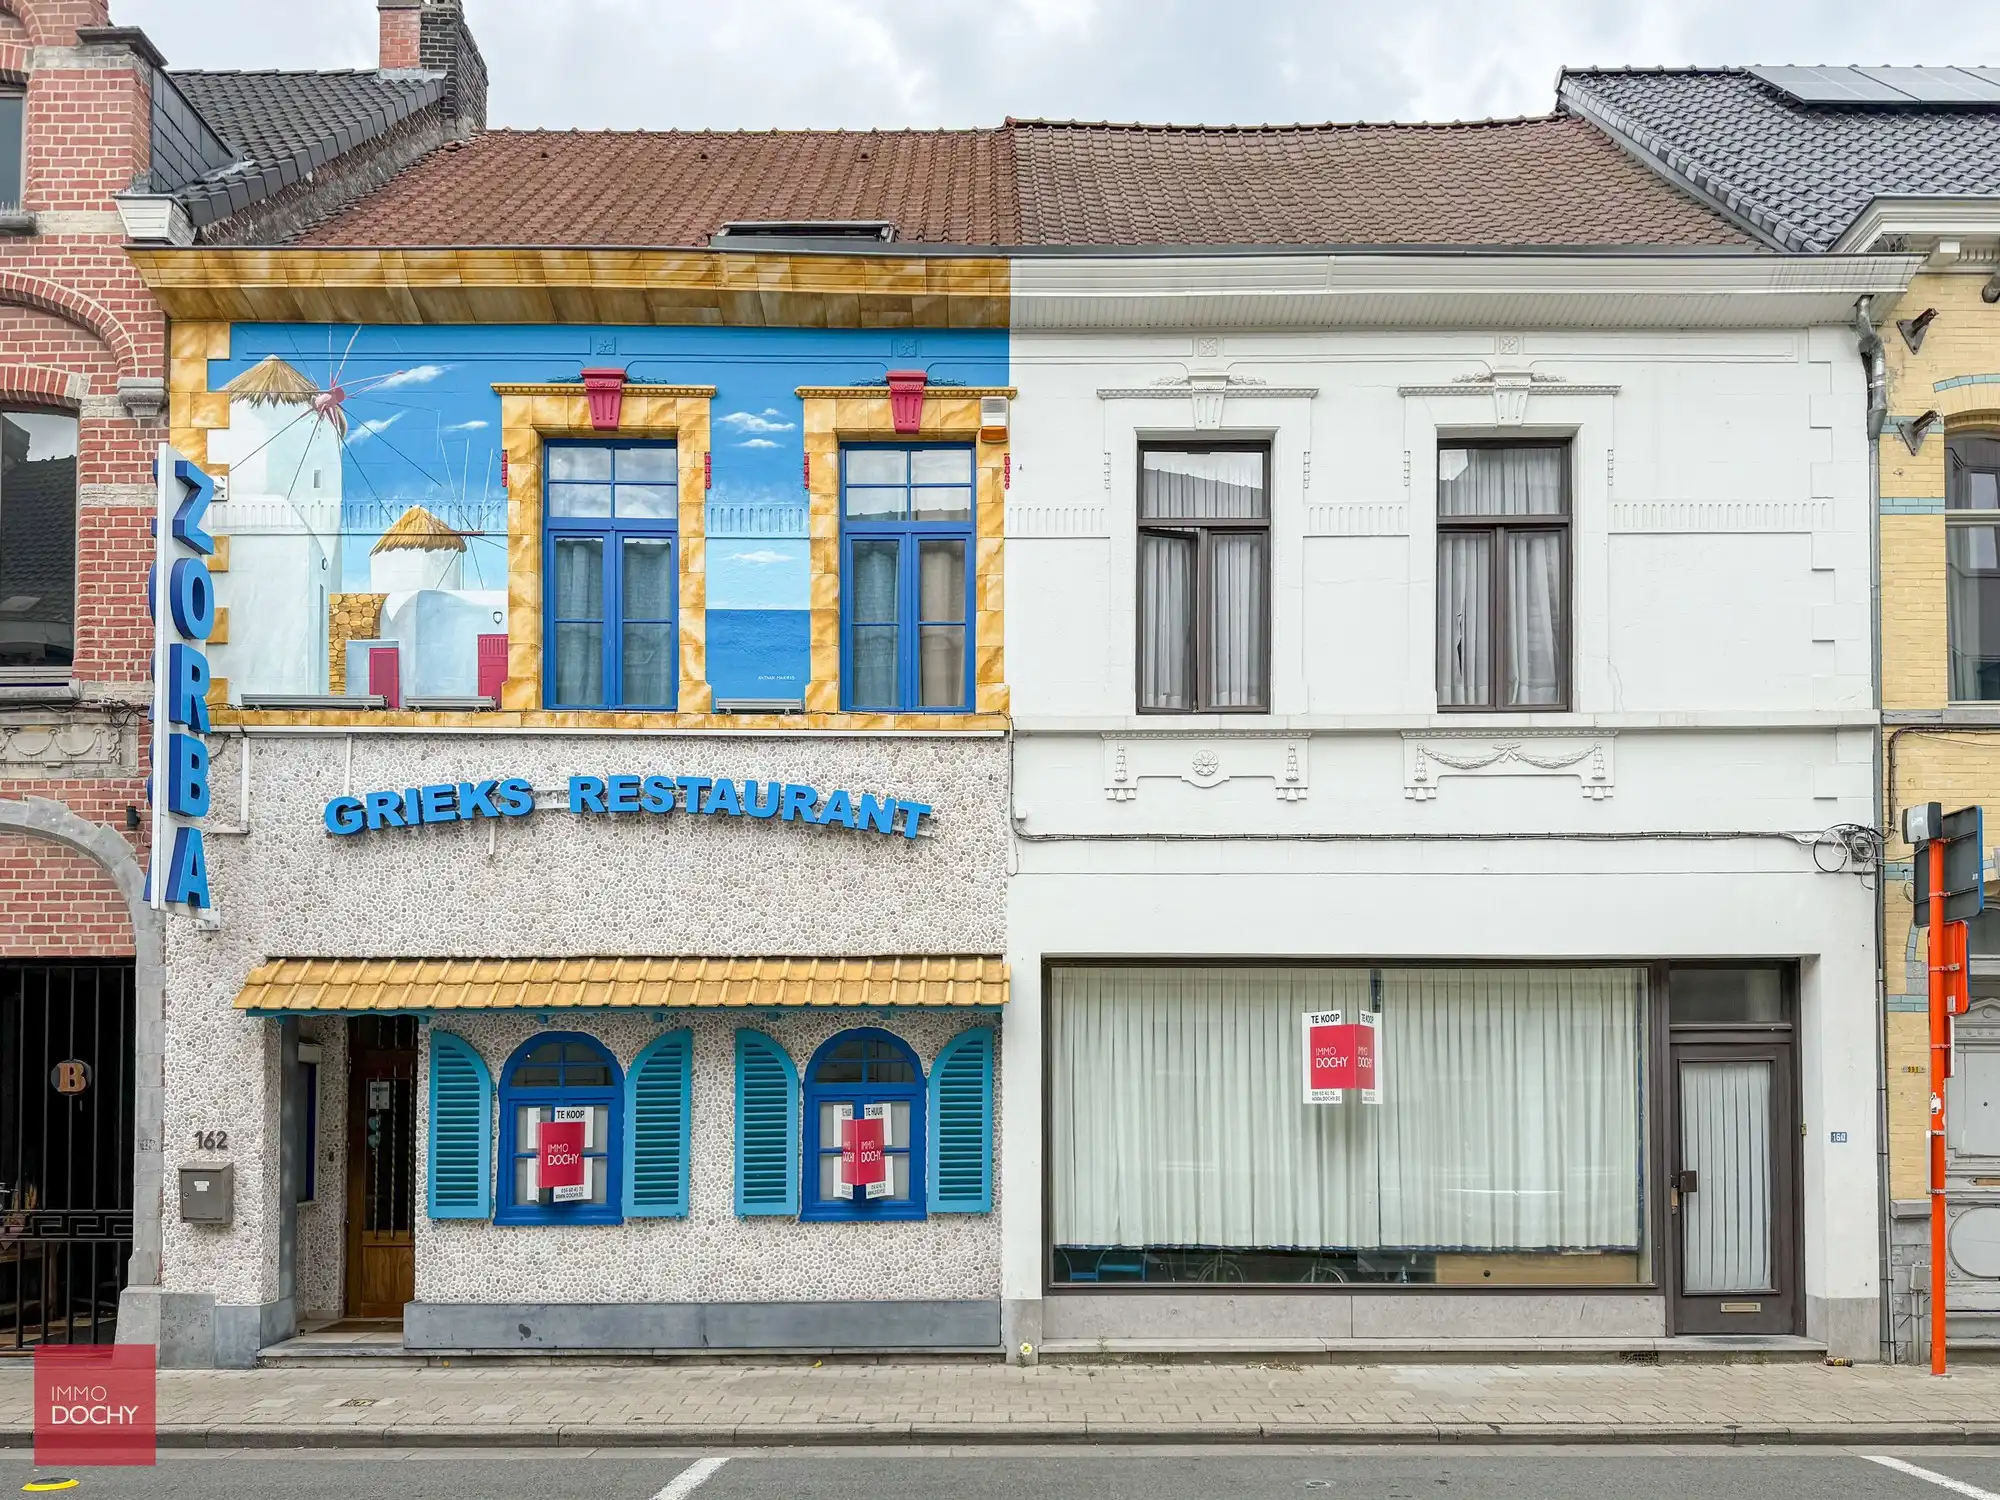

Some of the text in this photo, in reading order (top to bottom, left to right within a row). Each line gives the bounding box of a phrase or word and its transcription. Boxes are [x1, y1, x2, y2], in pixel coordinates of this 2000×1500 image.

[165, 460, 215, 909] ZORBA
[324, 775, 932, 840] GRIEKS RESTAURANT
[1311, 1013, 1340, 1024] TE KOOP
[1316, 1046, 1336, 1056] IMMO
[1316, 1056, 1348, 1068] DOCHY
[58, 1063, 86, 1092] B
[557, 1110, 584, 1119] TE KOOP
[866, 1108, 870, 1116] TE
[194, 1130, 228, 1150] 162
[548, 1144, 568, 1153] IMMO
[548, 1154, 580, 1166] DOCHY
[861, 1150, 882, 1163] DOCHY
